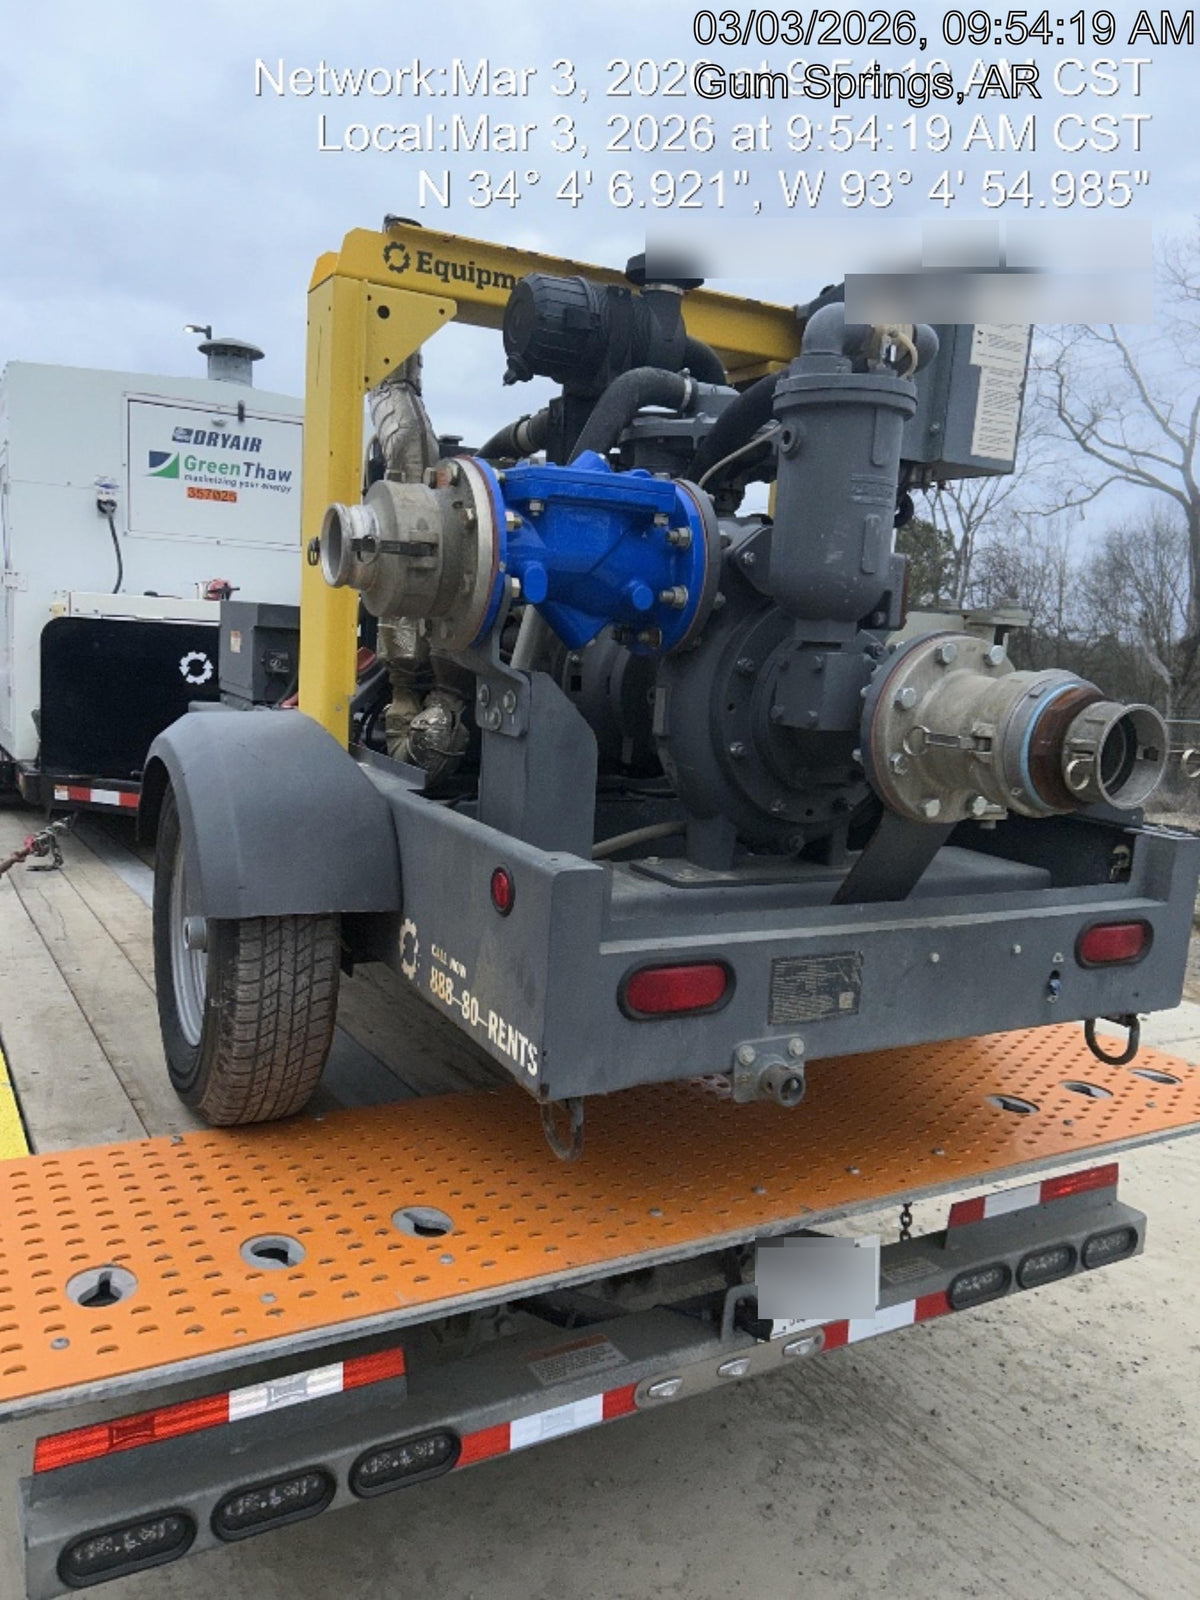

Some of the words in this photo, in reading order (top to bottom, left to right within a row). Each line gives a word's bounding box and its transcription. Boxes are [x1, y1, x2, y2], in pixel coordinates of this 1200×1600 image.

[416, 250, 524, 290] Equipm
[192, 429, 263, 453] DRYAIR
[184, 454, 292, 483] GreenThaw
[429, 965, 538, 1077] 888-80-RENTS
